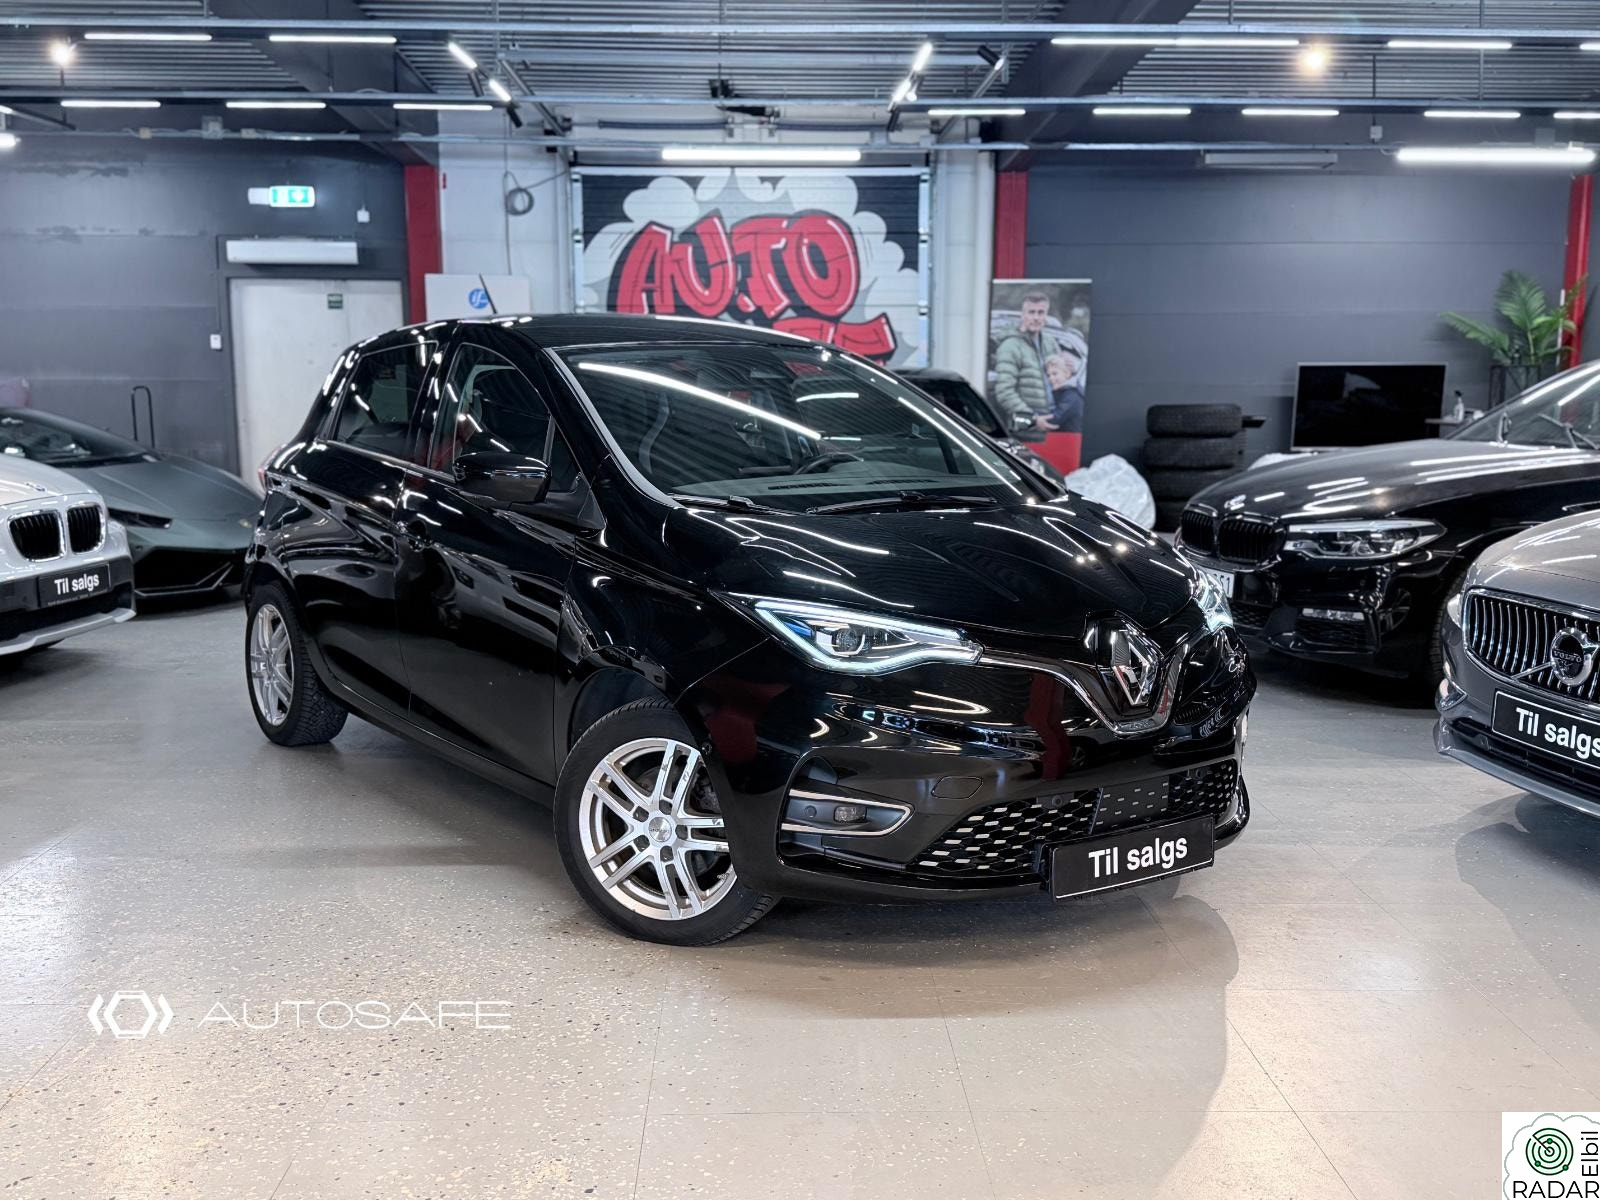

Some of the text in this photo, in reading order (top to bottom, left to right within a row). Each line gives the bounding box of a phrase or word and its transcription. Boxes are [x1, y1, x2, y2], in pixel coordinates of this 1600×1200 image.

[607, 209, 861, 319] AUTO
[54, 573, 100, 595] Til salgs
[1516, 706, 1540, 737] Til
[1088, 837, 1188, 878] Til salgs
